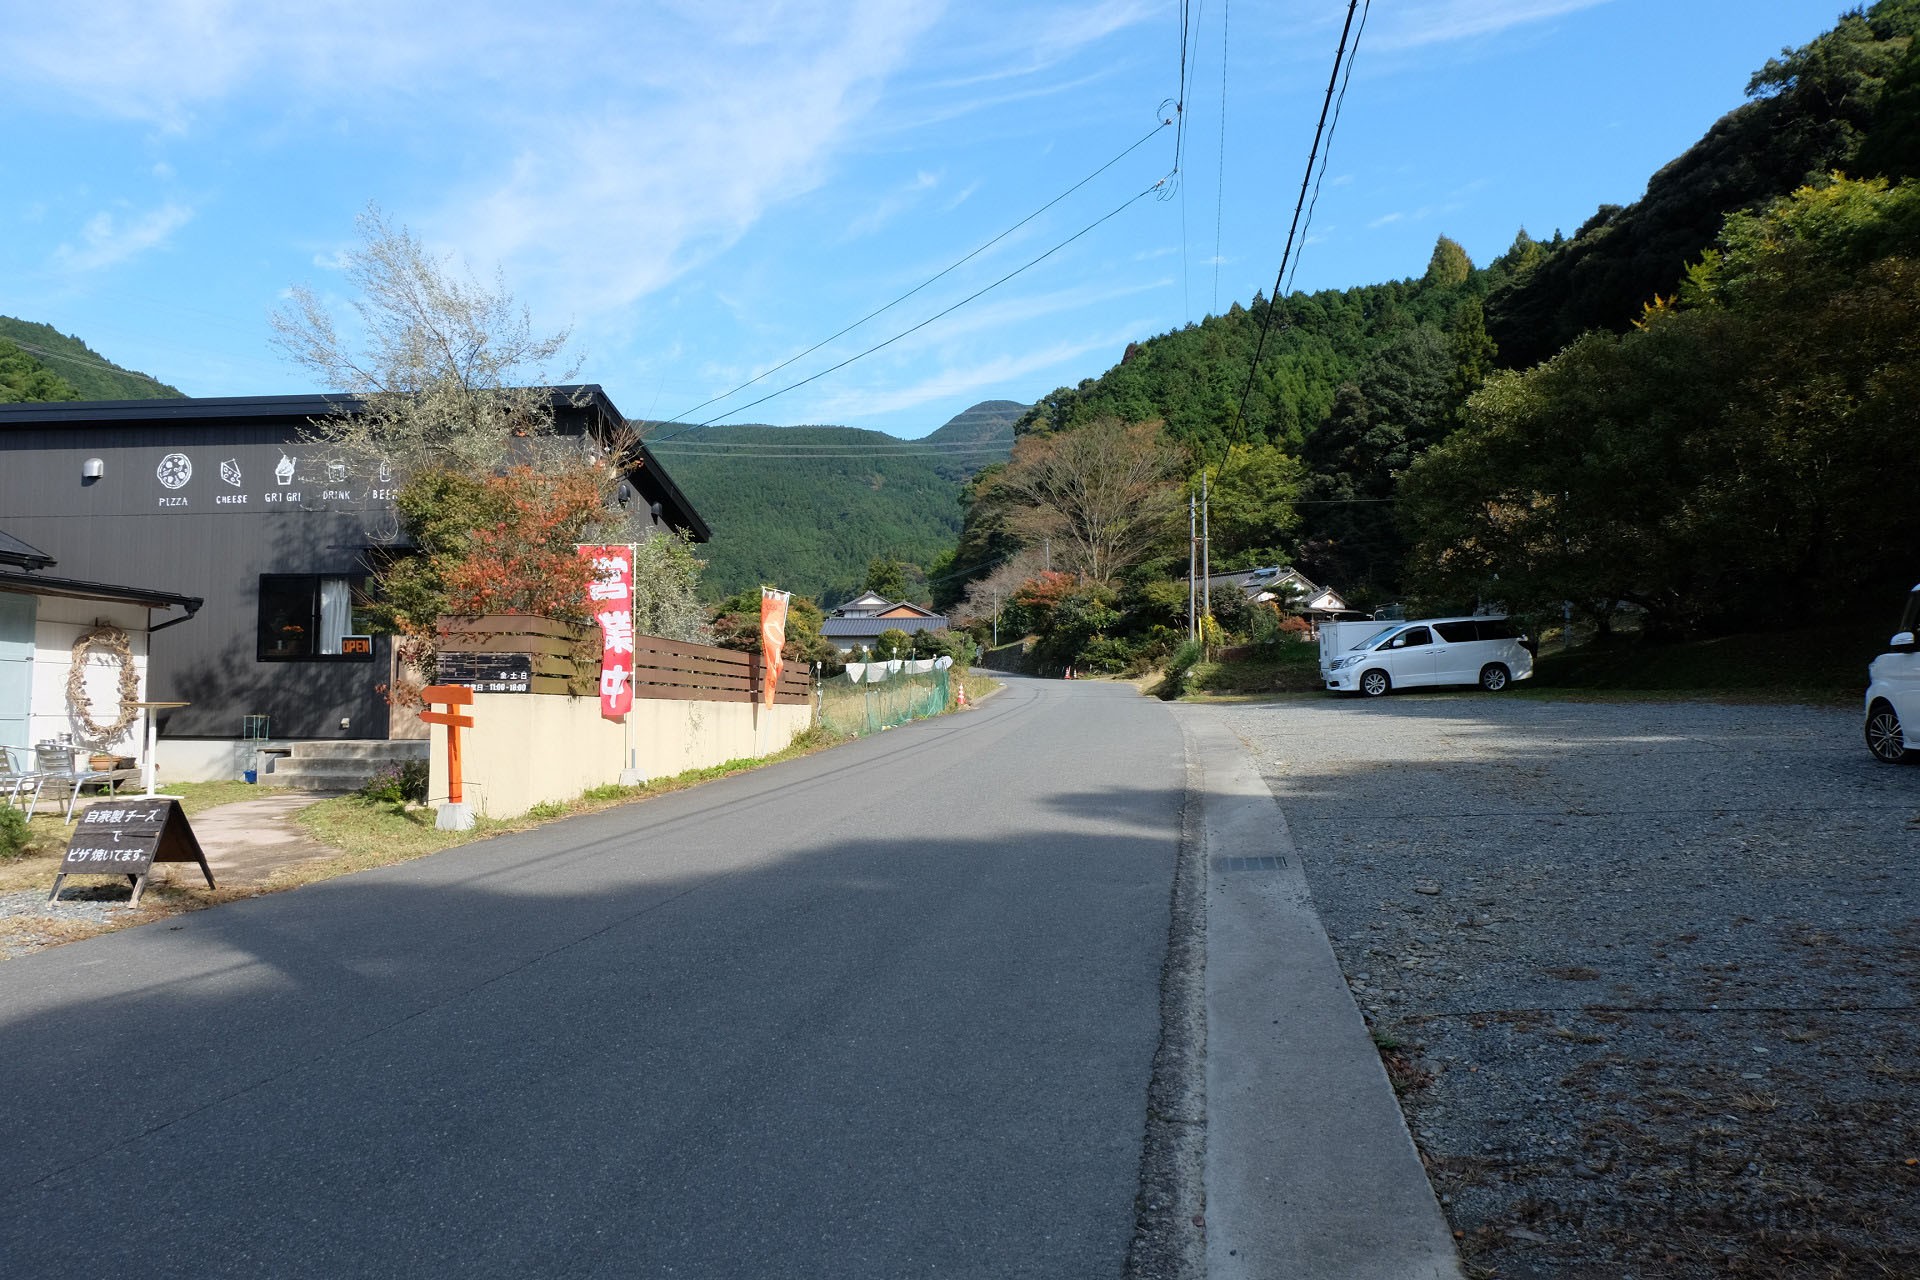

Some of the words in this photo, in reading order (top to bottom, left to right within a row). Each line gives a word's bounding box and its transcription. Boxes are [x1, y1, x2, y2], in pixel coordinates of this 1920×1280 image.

[216, 494, 248, 504] CHEESE
[264, 493, 282, 503] GRI
[286, 492, 301, 502] GRI
[322, 490, 351, 500] DRINK
[159, 497, 188, 506] PIZZA
[589, 556, 633, 709] 営業中
[342, 640, 369, 653] OPEN
[112, 830, 123, 842] で
